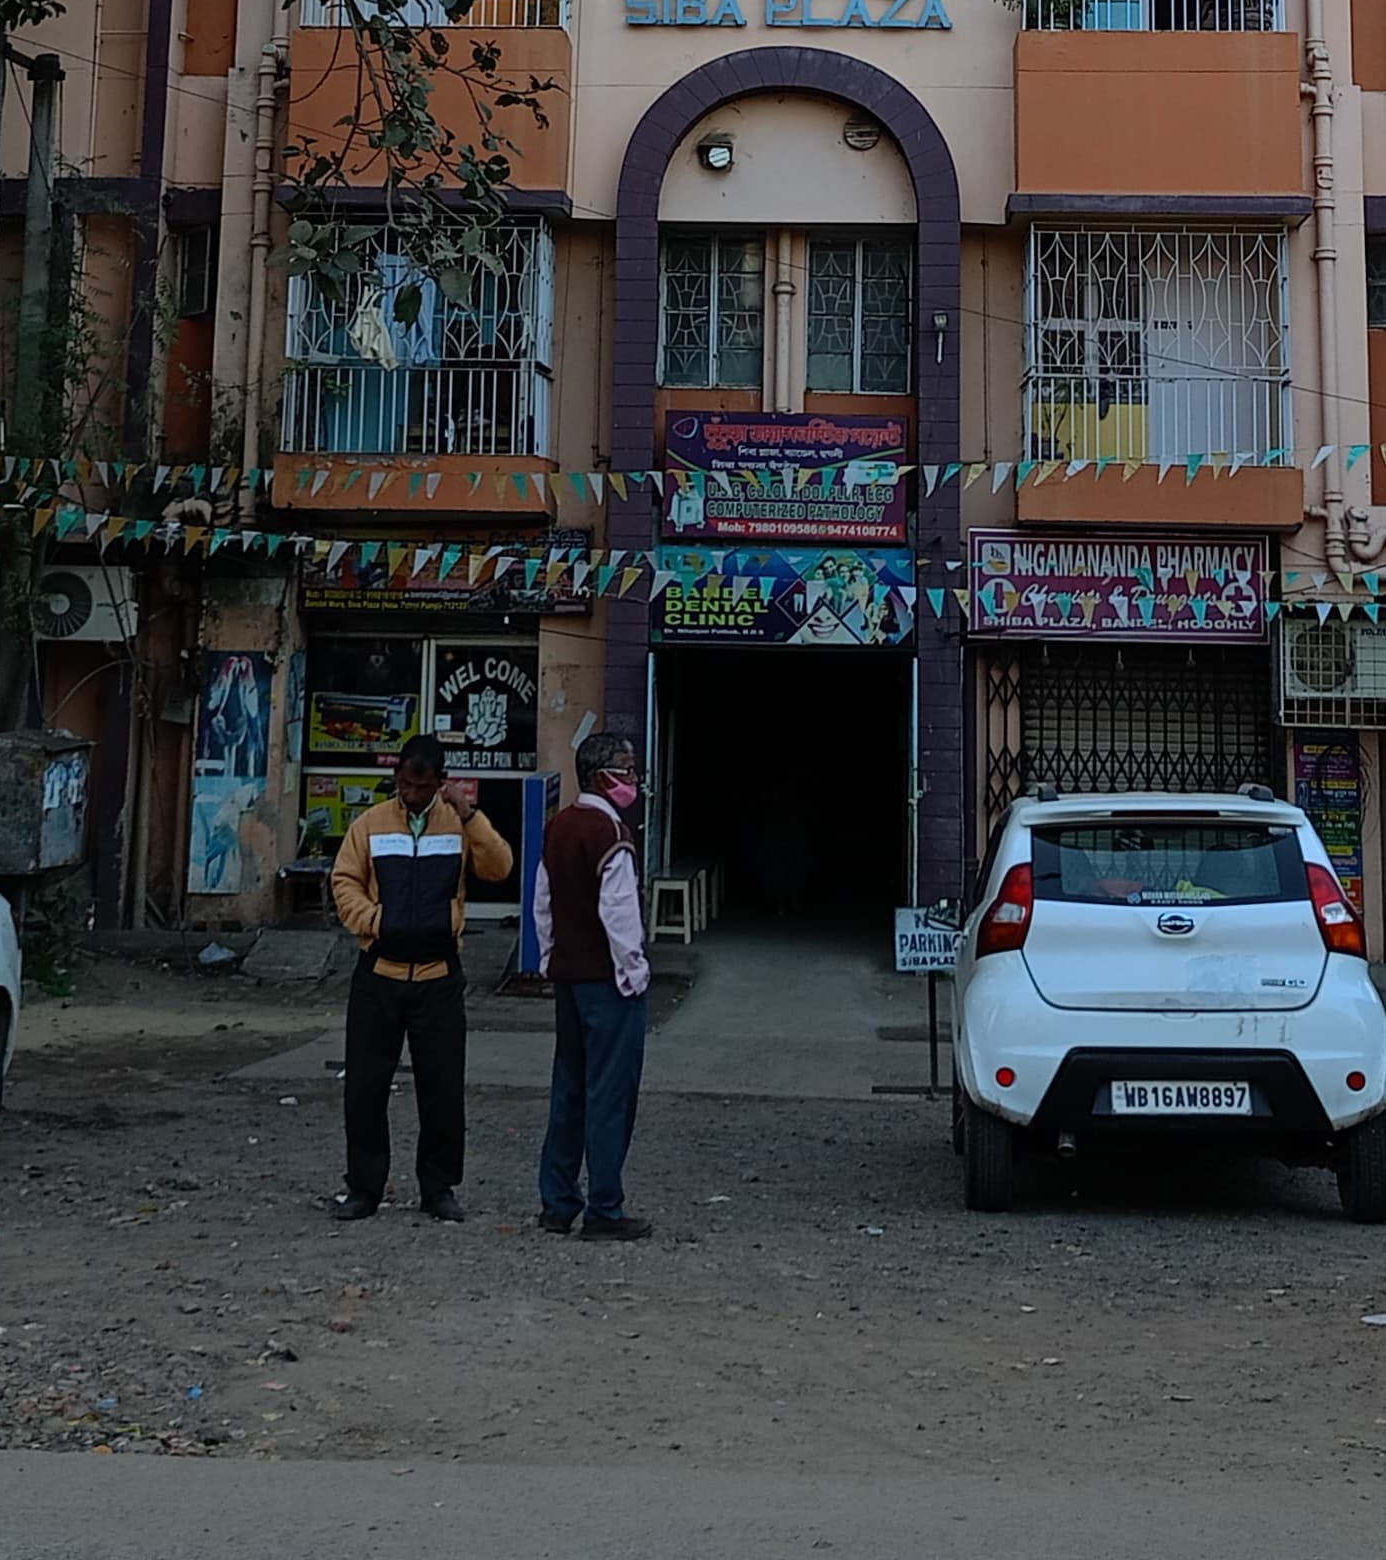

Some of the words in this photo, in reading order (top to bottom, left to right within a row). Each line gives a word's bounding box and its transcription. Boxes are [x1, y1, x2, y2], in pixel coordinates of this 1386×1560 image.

[866, 486, 894, 503] ECG
[706, 500, 806, 520] COMPUTERIZED
[807, 503, 885, 522] PATHOLOGY
[717, 521, 745, 533] Mob:
[1014, 543, 1152, 578] NIGAMANANDA
[1157, 545, 1255, 579] PHARMACY
[665, 600, 769, 613] DENTAL
[664, 613, 755, 626] CLINIC
[1177, 618, 1257, 630] HOOGHLY
[899, 933, 962, 953] PARKING
[929, 956, 956, 966] PLAZ
[1123, 1084, 1247, 1109] WB16AW8897
